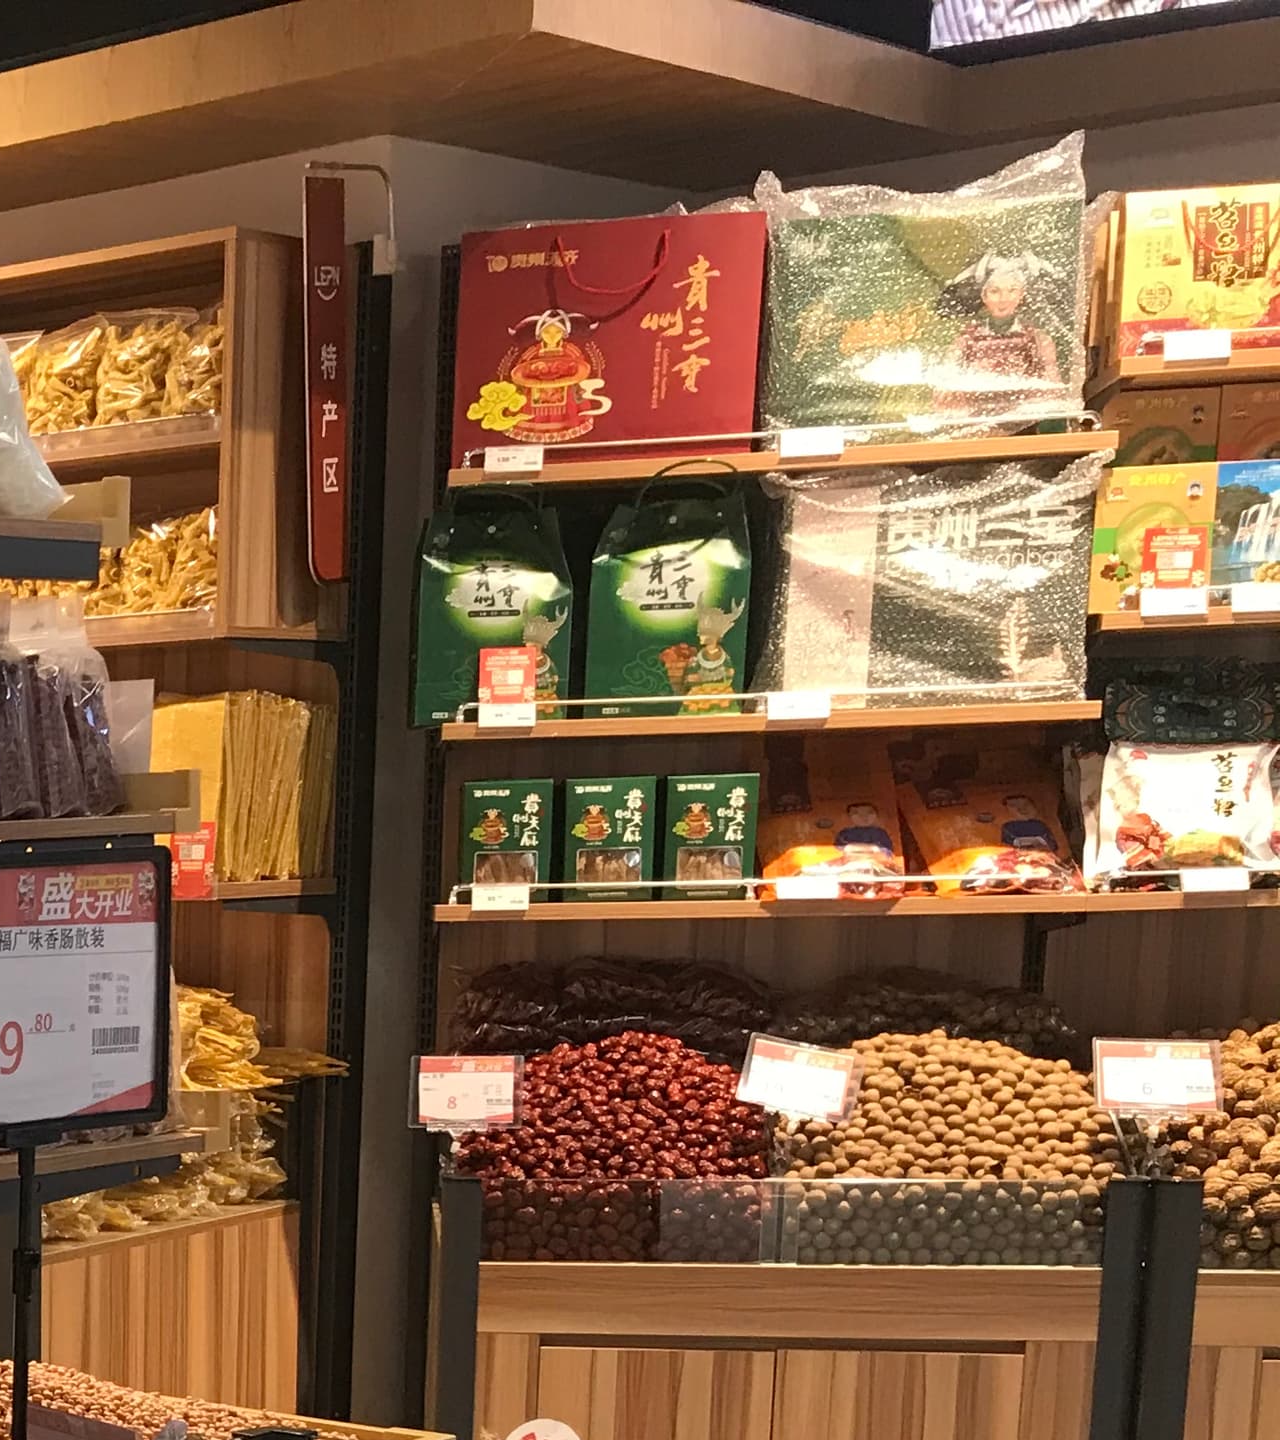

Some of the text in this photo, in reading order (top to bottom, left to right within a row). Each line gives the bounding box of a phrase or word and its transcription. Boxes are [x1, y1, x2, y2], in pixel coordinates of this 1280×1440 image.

[320, 344, 339, 492] 特产区
[39, 872, 133, 921] 盛大开业
